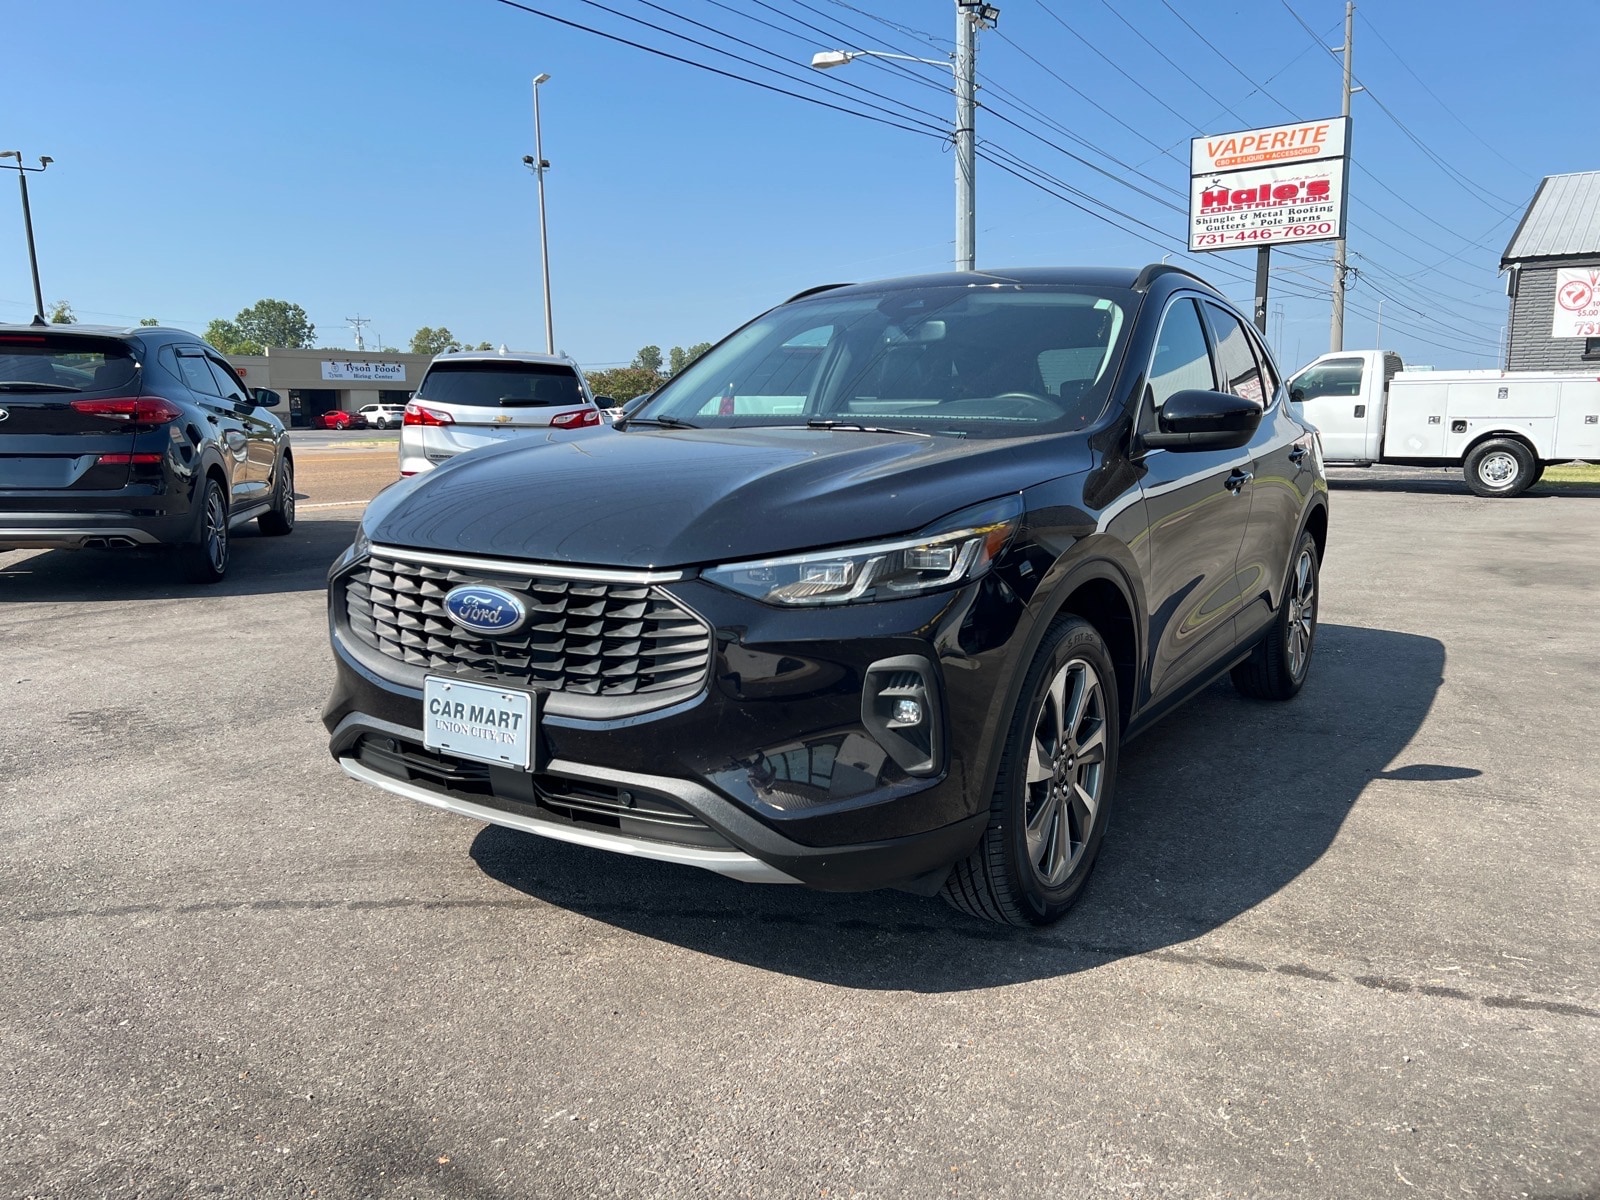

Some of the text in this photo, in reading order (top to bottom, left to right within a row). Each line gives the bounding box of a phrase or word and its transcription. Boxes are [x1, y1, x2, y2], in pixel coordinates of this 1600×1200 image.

[1207, 125, 1329, 158] VAPER!TE
[1216, 147, 1319, 166] CBD E-LIQUID ACCESSORIES
[1200, 195, 1329, 214] CONSTRUCTION
[1201, 180, 1330, 208] Hale's
[1195, 214, 1235, 225] Shingle
[1253, 209, 1283, 219] Metal
[1288, 205, 1334, 215] Roofing
[1206, 214, 1321, 231] Gutters Pole Barns
[1196, 222, 1331, 245] 731-446-7620
[344, 364, 400, 373] Tyson Foods
[459, 595, 502, 624] Ford
[429, 698, 523, 730] CAR MART
[435, 719, 516, 744] UNION CITY, TN
